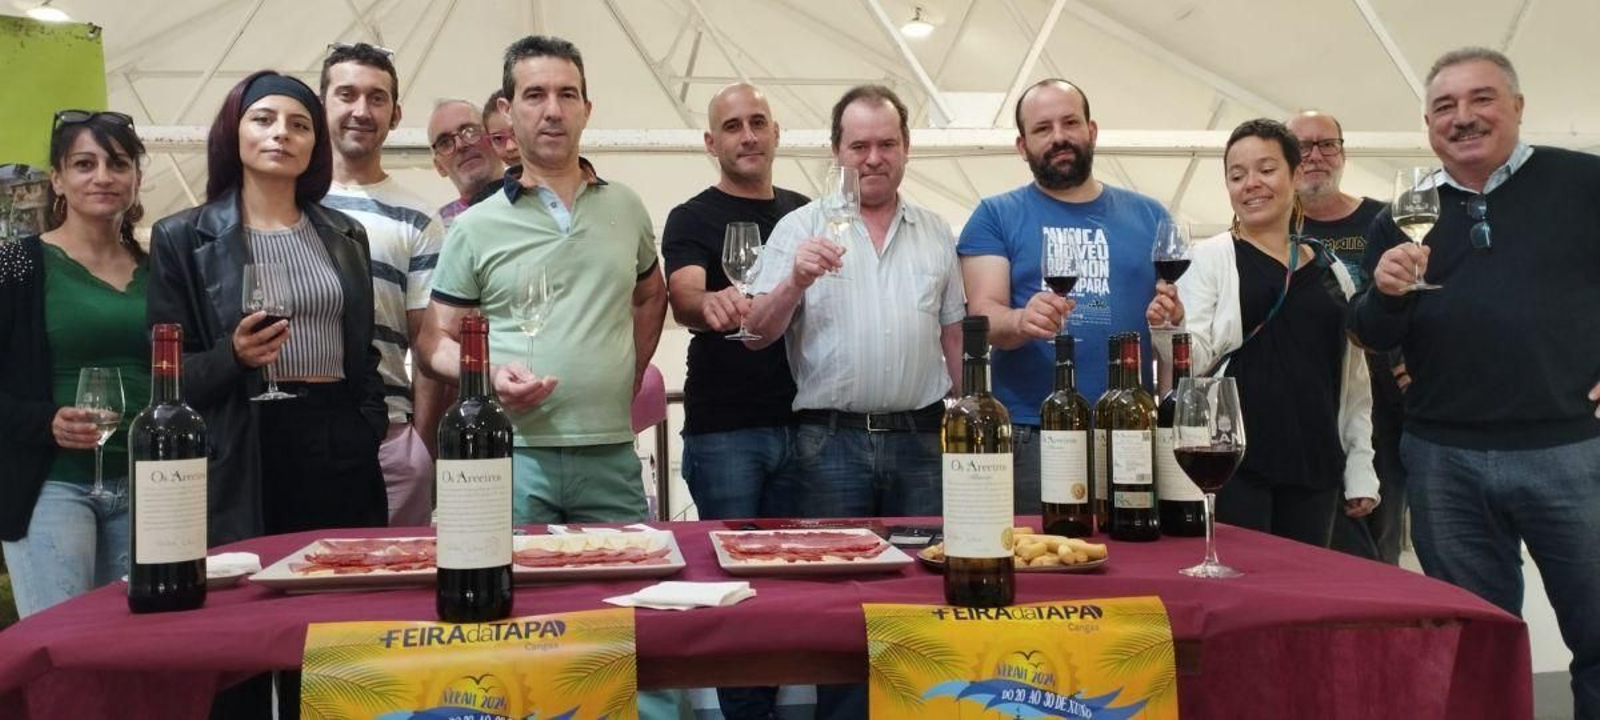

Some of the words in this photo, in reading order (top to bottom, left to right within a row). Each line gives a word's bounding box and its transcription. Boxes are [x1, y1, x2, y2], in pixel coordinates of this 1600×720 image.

[1043, 227, 1108, 245] NUNCA
[1324, 236, 1368, 252] MAID
[1076, 259, 1110, 278] NON
[1041, 277, 1109, 296] EPARA
[1067, 623, 1099, 633] Cangas
[1014, 688, 1026, 702] 20
[1028, 688, 1042, 705] AO
[1043, 691, 1055, 708] 30
[1055, 694, 1067, 711] DE
